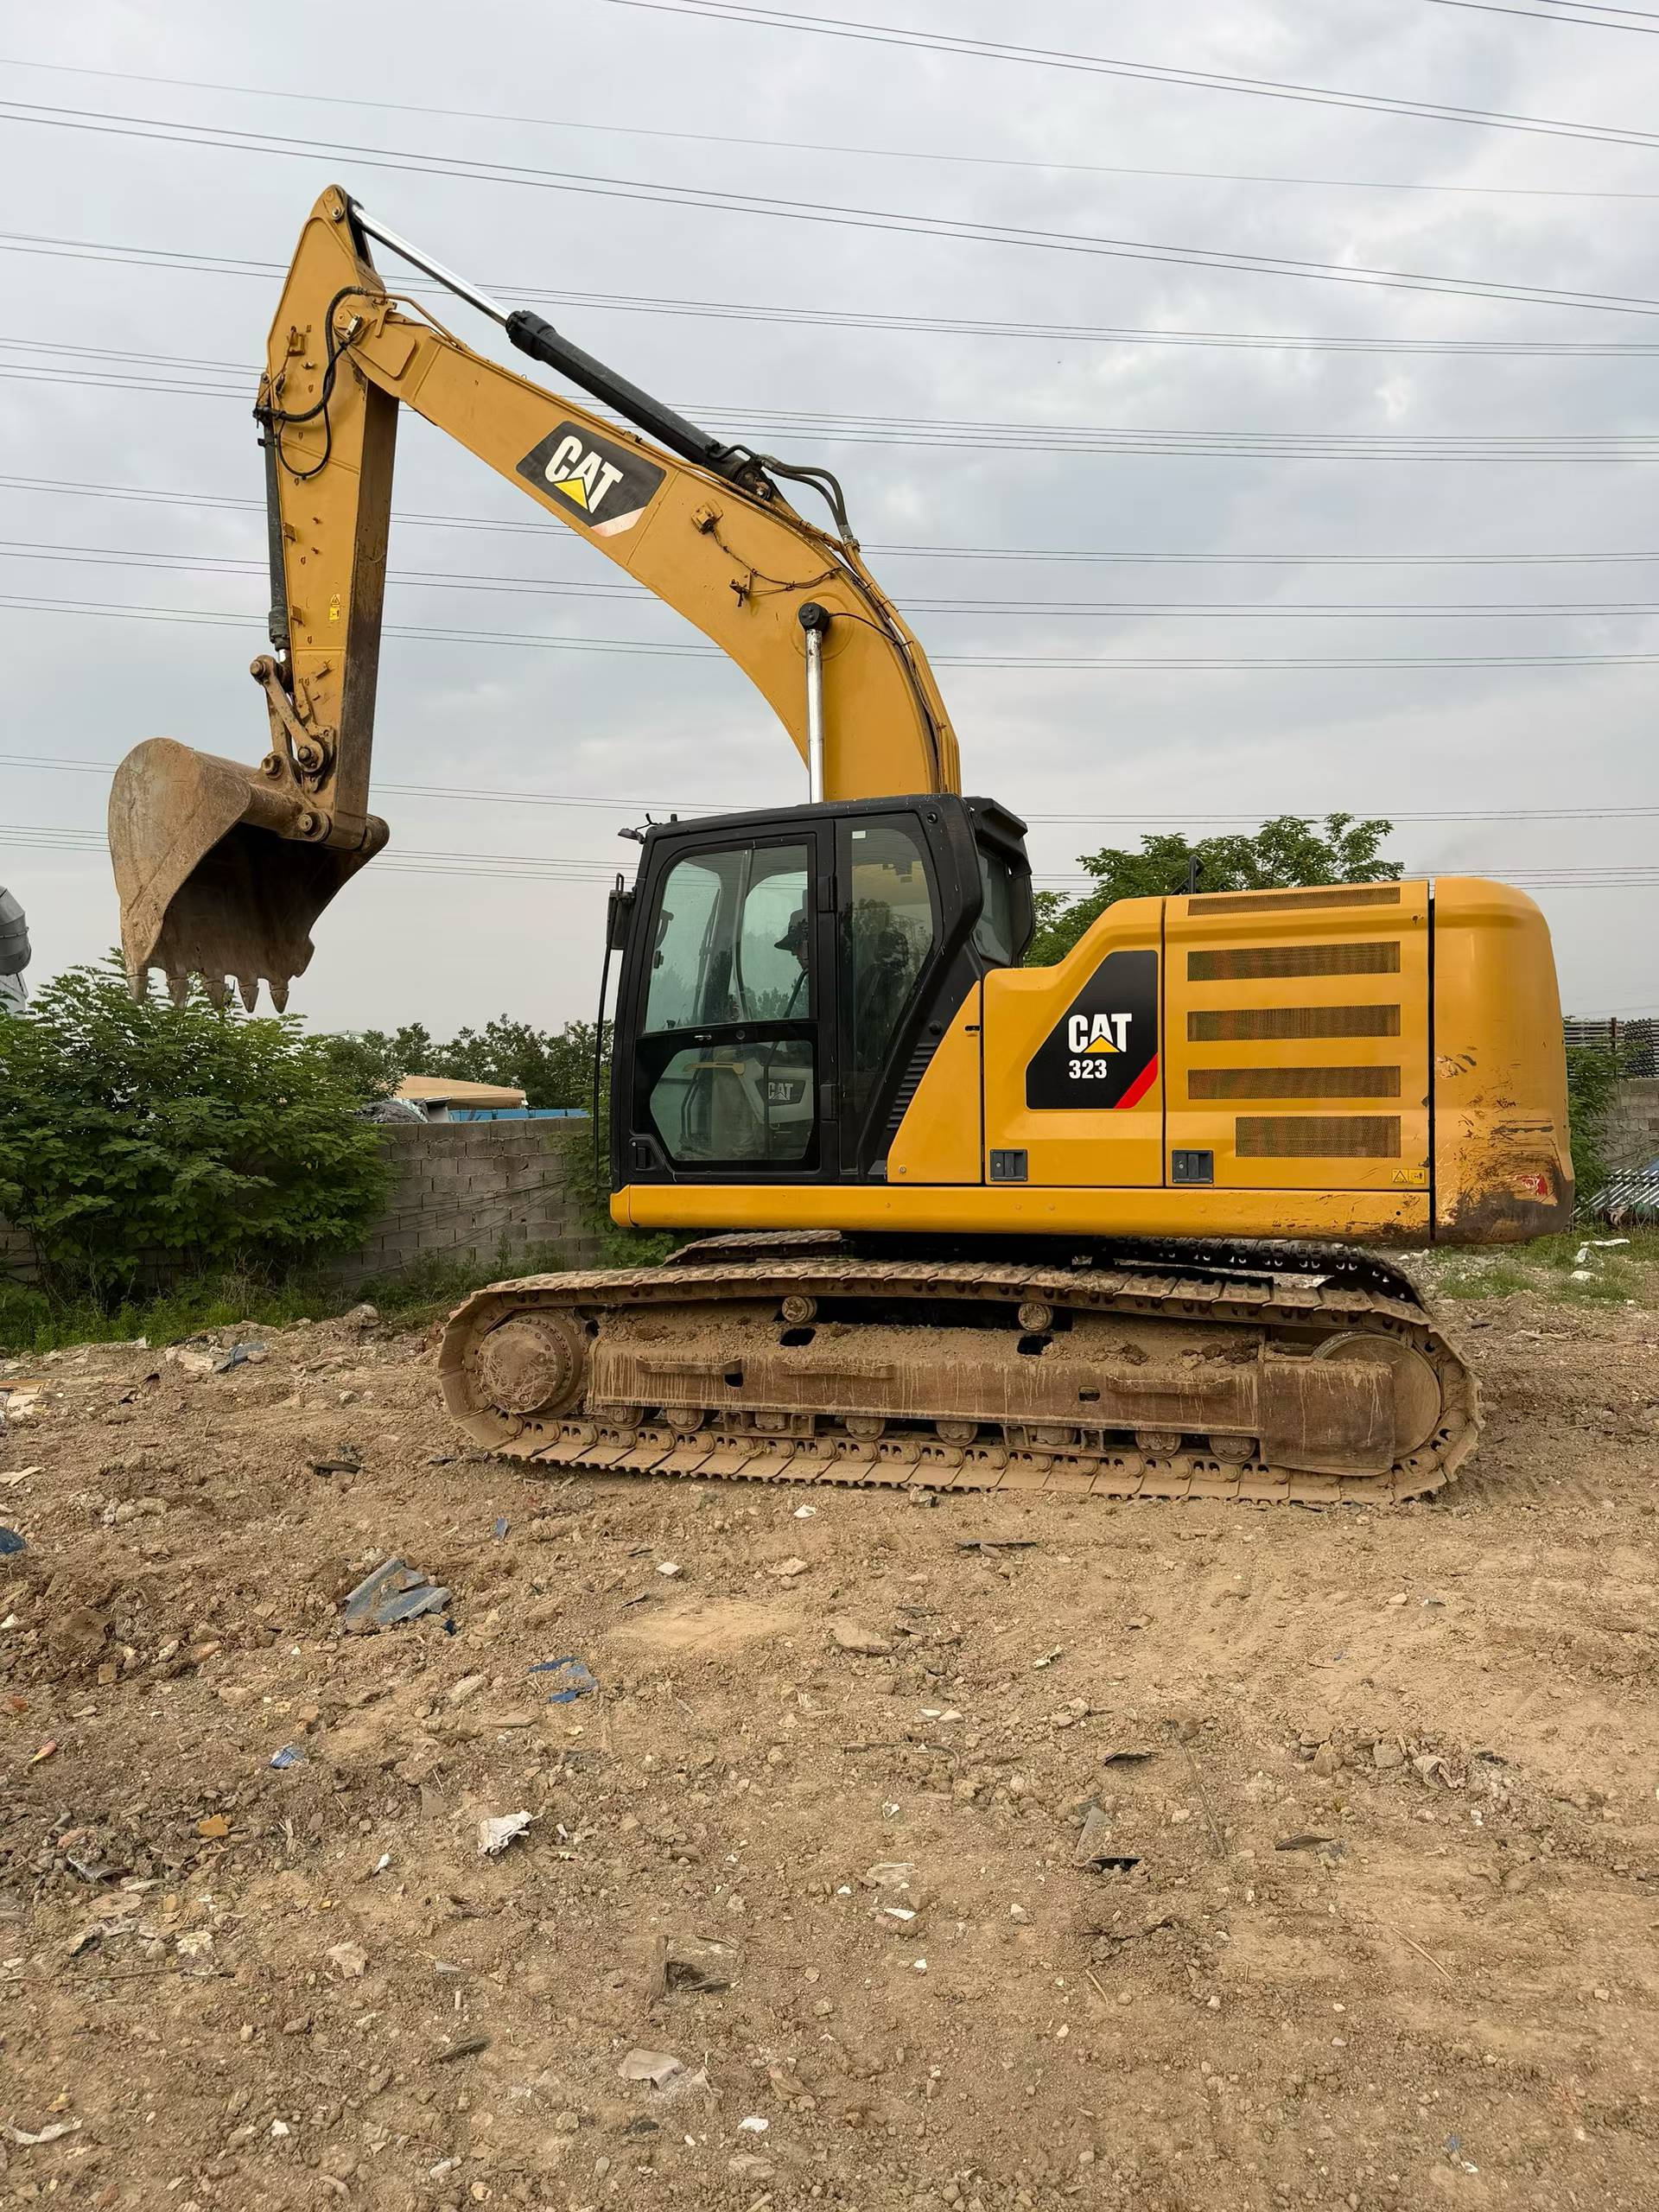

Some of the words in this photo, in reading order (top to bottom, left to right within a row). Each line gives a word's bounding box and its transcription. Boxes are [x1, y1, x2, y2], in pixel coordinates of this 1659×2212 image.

[545, 435, 624, 513] CAT
[1068, 1014, 1133, 1053] CAT
[1069, 1059, 1107, 1079] 323
[768, 1082, 793, 1100] CAT
